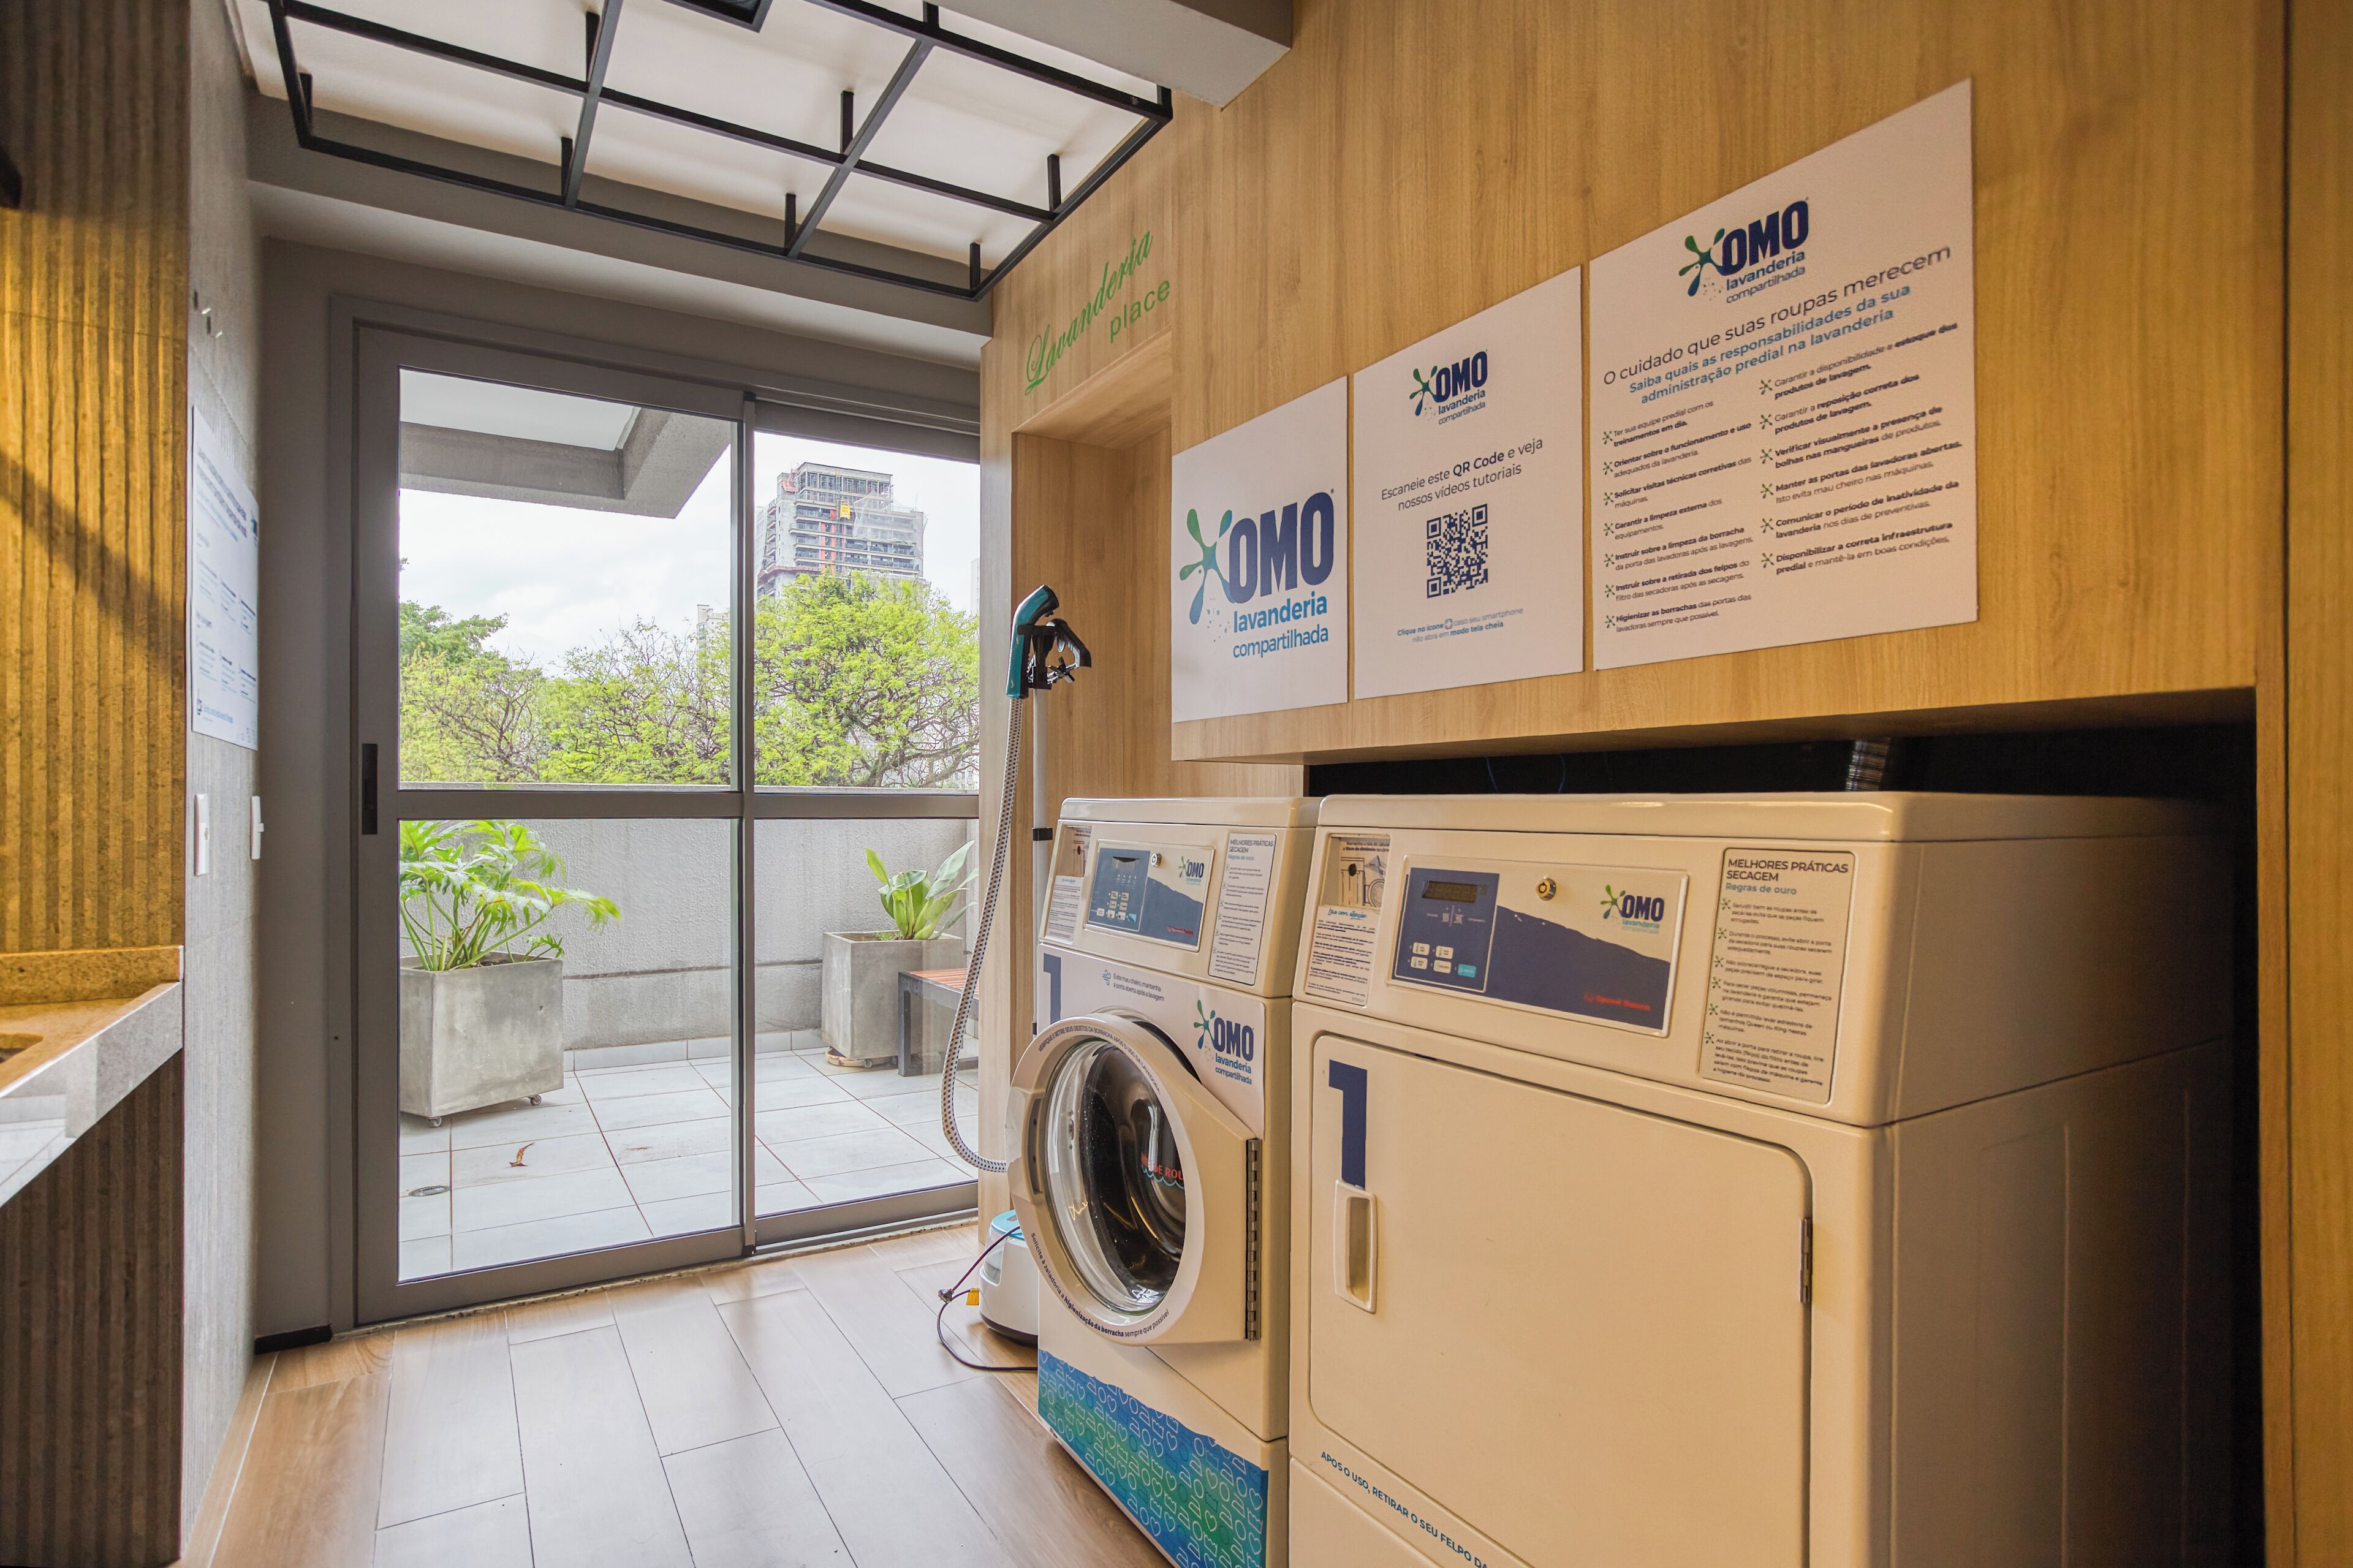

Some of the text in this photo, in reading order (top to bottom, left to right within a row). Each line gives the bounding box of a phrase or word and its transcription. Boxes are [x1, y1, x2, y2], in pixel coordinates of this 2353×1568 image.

[1722, 200, 1809, 276] OMO
[1727, 251, 1805, 290] lavanderia
[1727, 265, 1805, 303] compartilhada
[1025, 230, 1153, 396] Lavanderia
[1110, 280, 1170, 344] place
[1604, 246, 1951, 384] O cuidado que suas roupas merecem
[1630, 286, 1911, 393] Saiba quais as responsabilidades da sua
[1642, 309, 1894, 403] administração predial na lavanderia
[1436, 352, 1488, 403] OMO
[1438, 401, 1485, 425] compartilhada
[1439, 389, 1485, 415] lavanderia
[1637, 417, 1661, 430] equipe
[1662, 409, 1686, 422] predial
[1688, 404, 1703, 413] com
[1614, 428, 1660, 447] treinamentos
[1614, 455, 1642, 468] Orientar
[1643, 448, 1662, 458] sobre
[1671, 429, 1728, 450] funcionamento
[1737, 423, 1751, 431] uso
[1381, 437, 1543, 500] Escaneie este QR Code e veja
[1614, 463, 1651, 478] adequados
[1662, 450, 1698, 464] lavanderia.
[1615, 457, 1751, 498] Solicitar visitas técnicas corretivas das
[1776, 479, 1806, 491] Manter
[1820, 470, 1849, 483] portas
[1851, 464, 1868, 474] das
[1870, 452, 1918, 469] lavadoras
[1920, 441, 1962, 457] abertas.
[1398, 463, 1522, 511] nossos vídeos tutoriais
[1615, 518, 1642, 529] Garantir
[1650, 510, 1677, 521] limpeza
[1679, 503, 1707, 515] externa
[1615, 523, 1664, 540] equipamentos.
[1229, 492, 1335, 604] OMO
[1776, 544, 1836, 562] Disponibilizar
[1846, 536, 1879, 548] correta
[1882, 523, 1953, 542] infraestrutura
[1233, 591, 1327, 633] lavanderia
[1397, 628, 1416, 637] Clique
[1482, 608, 1523, 621] smartphone
[1450, 626, 1469, 636] modo
[1233, 624, 1328, 658] compartilhada
[1186, 862, 1204, 878] OMO
[1727, 870, 1778, 881] SECAGEM
[1728, 858, 1848, 873] MELHORES PRÁTICAS
[1726, 883, 1757, 893] Regras
[1622, 895, 1664, 922] OMO
[1044, 953, 1061, 1025] 1
[1214, 1017, 1254, 1061] OMO
[1216, 1053, 1251, 1074] lavanderia
[1216, 1067, 1252, 1085] compartilhada
[1328, 1059, 1368, 1190] 1
[1031, 1233, 1043, 1259] Solicite
[1044, 1264, 1062, 1295] zeladoria
[1064, 1294, 1094, 1327] higienização
[1094, 1322, 1101, 1331] da
[1101, 1326, 1124, 1337] borracha
[1143, 1326, 1152, 1335] que
[1152, 1309, 1169, 1328] possível
[1321, 1452, 1343, 1472] APOS
[1343, 1467, 1350, 1477] O
[1352, 1472, 1370, 1494] USO,
[1373, 1487, 1409, 1518] RETIRAR
[1411, 1513, 1418, 1523] O
[1420, 1520, 1438, 1537] SEU
[1441, 1533, 1472, 1561] FELPO
